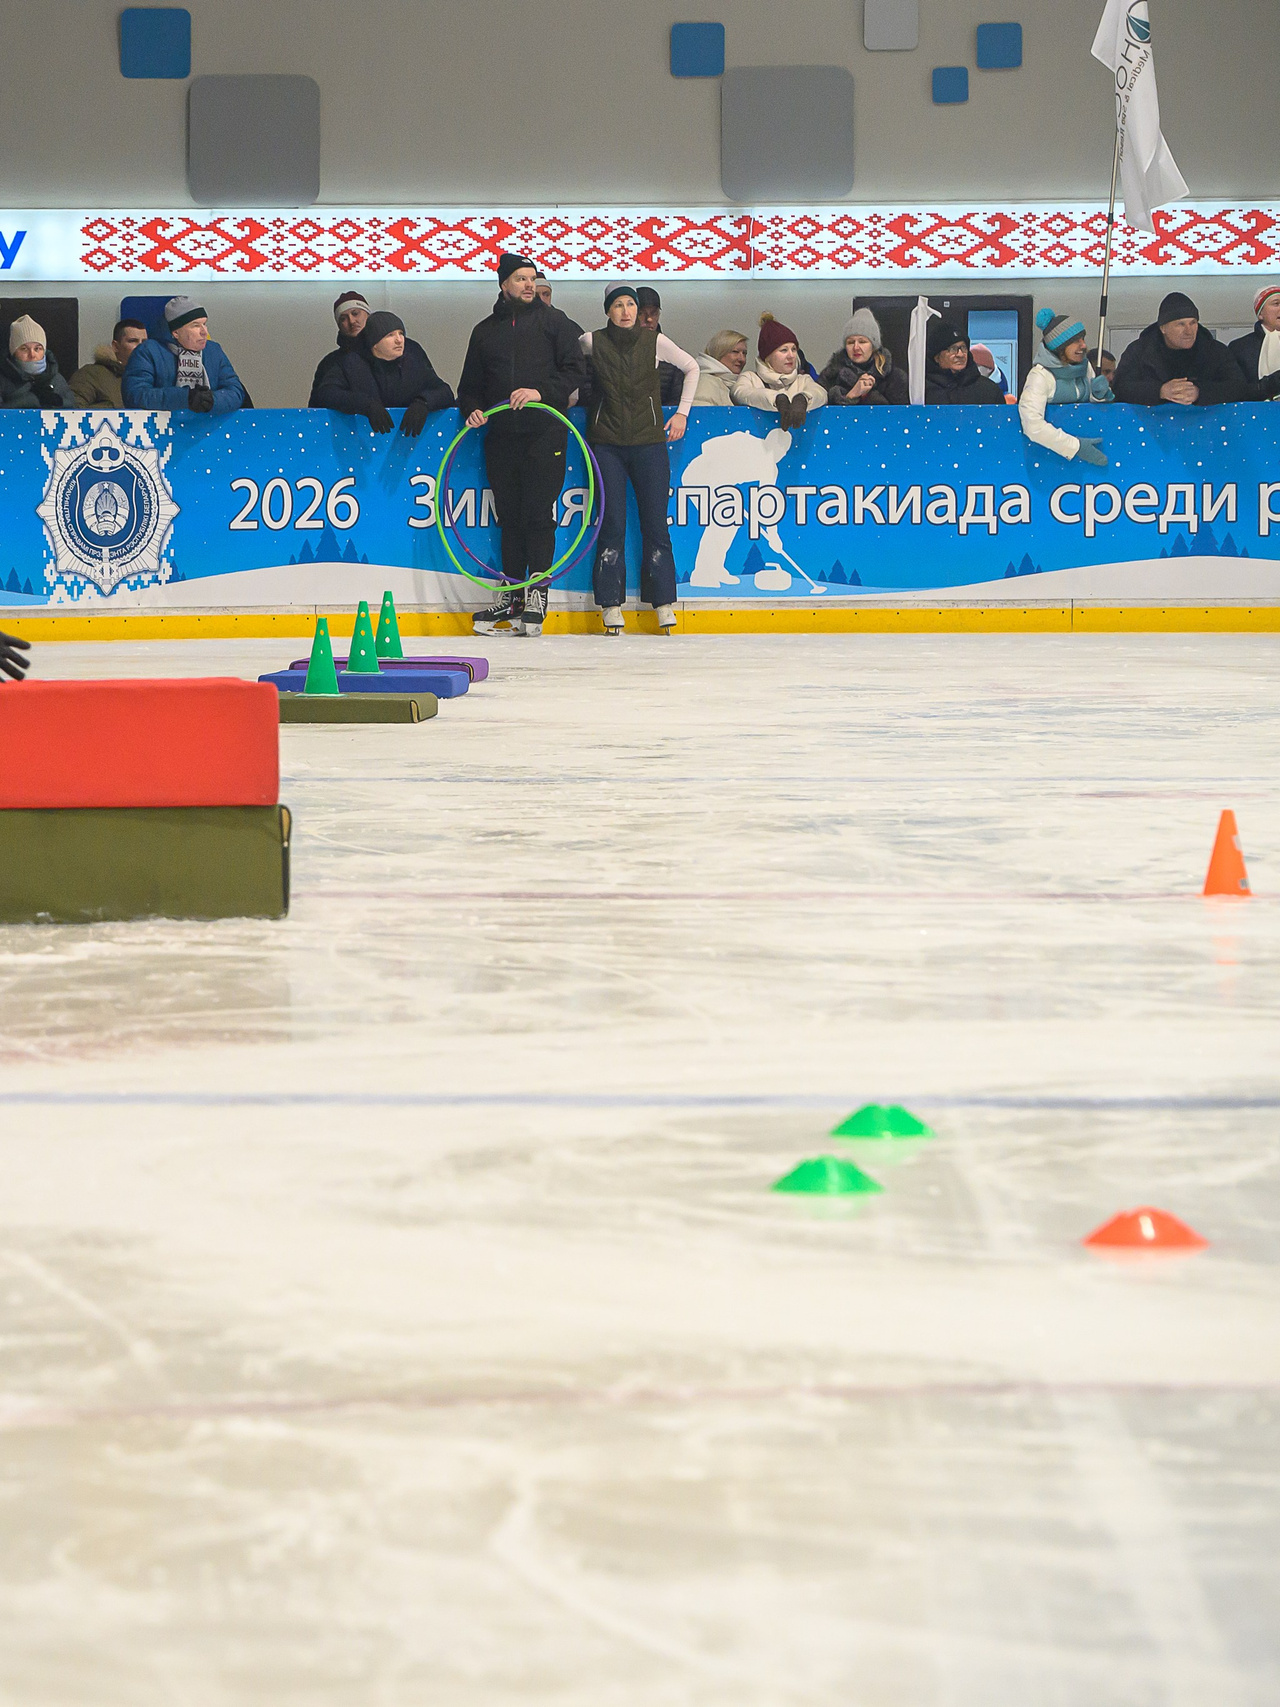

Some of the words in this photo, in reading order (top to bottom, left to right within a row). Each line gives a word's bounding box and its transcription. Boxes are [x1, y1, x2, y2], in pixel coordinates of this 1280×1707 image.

[228, 475, 361, 531] 2026
[667, 483, 1032, 540] партакиада
[1049, 482, 1238, 538] среди
